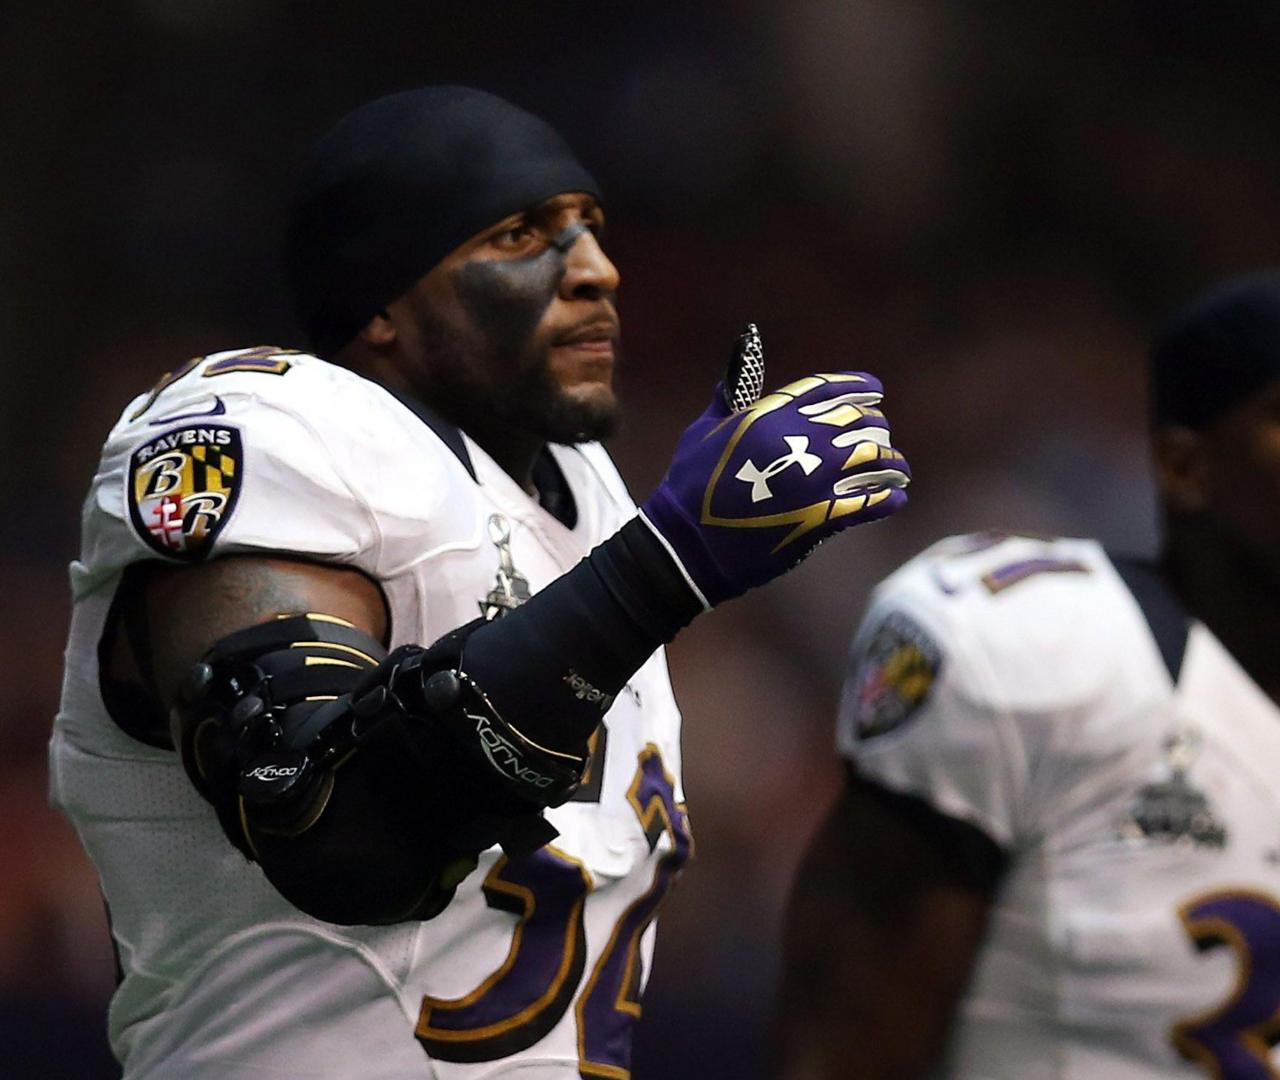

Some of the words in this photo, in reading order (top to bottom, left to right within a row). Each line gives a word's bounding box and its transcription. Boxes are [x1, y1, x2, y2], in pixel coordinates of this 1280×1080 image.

[135, 428, 231, 463] RAVENS
[138, 452, 187, 499] B
[181, 491, 228, 537] R
[464, 710, 555, 789] DONJOY
